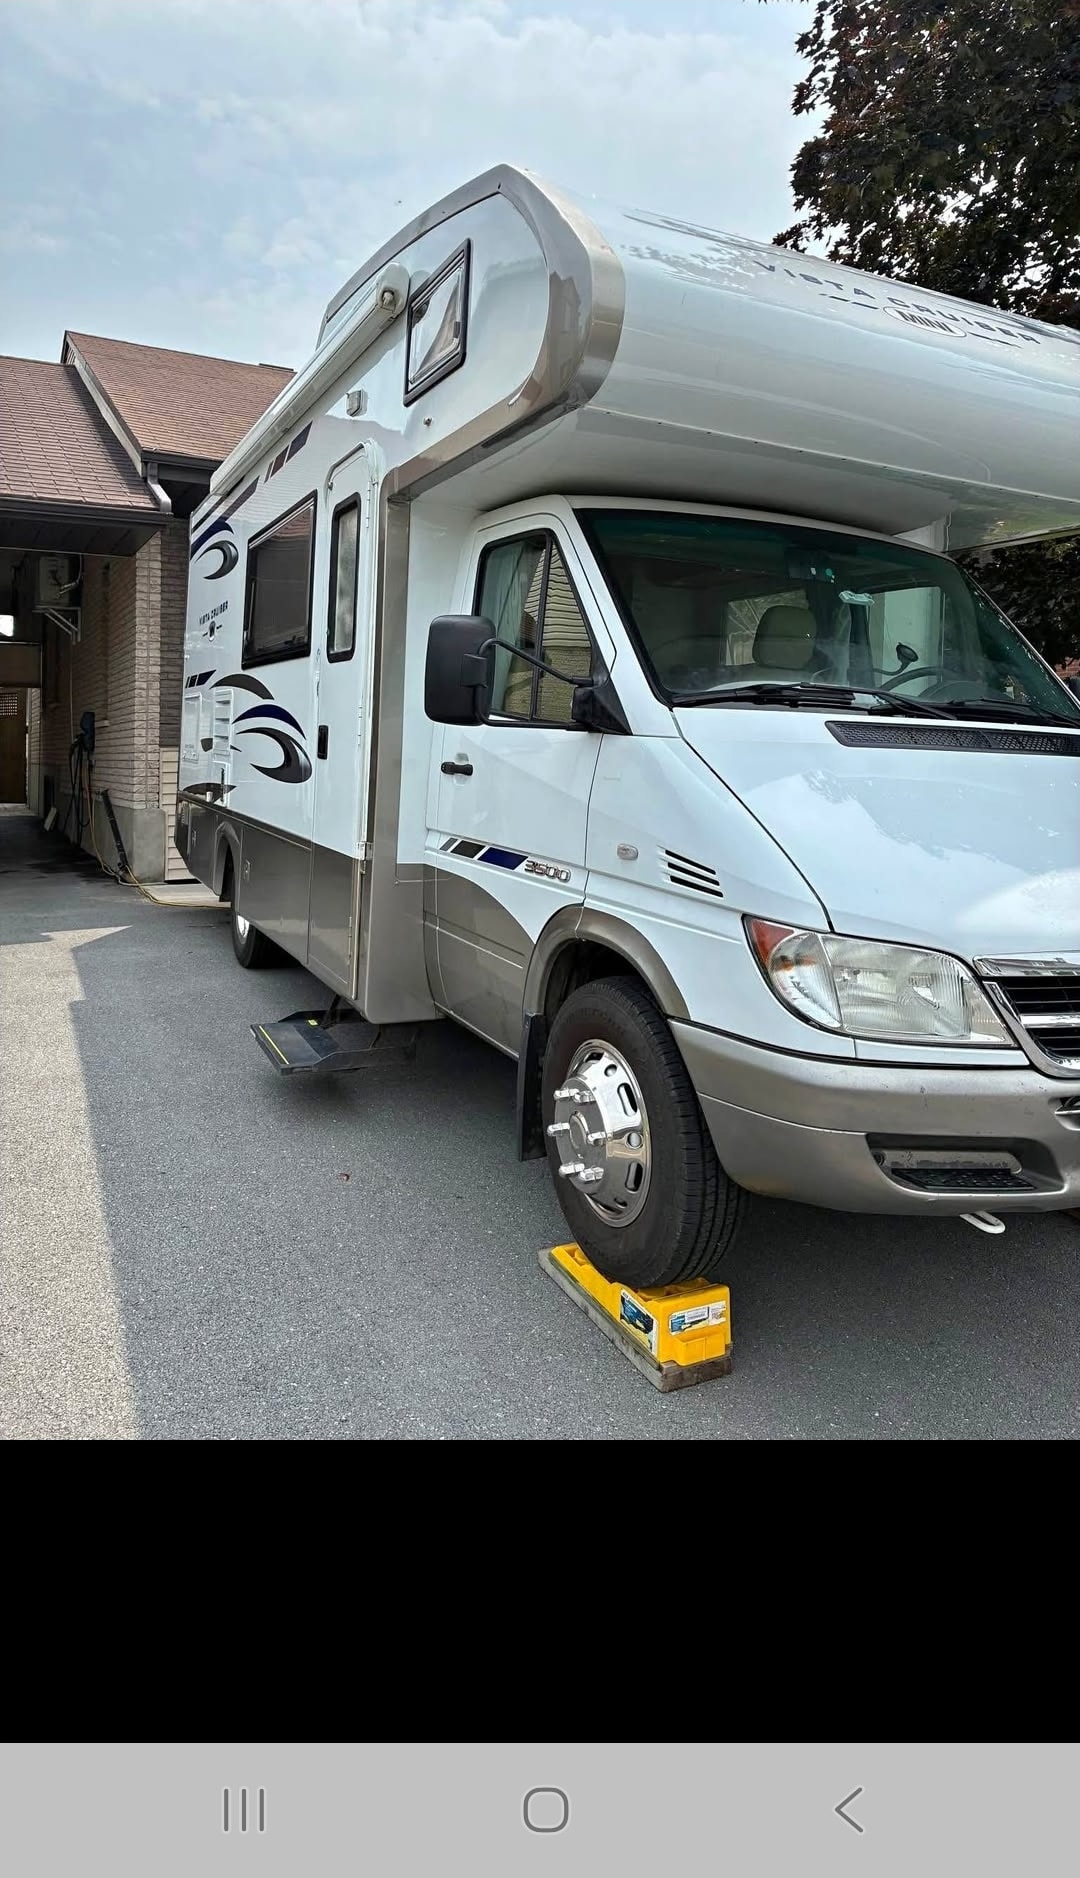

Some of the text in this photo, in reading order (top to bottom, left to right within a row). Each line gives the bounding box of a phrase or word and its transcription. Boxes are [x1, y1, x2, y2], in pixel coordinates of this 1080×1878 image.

[753, 260, 1041, 345] VISTA CRUISER
[895, 309, 955, 334] MINI
[524, 859, 571, 883] 3500
